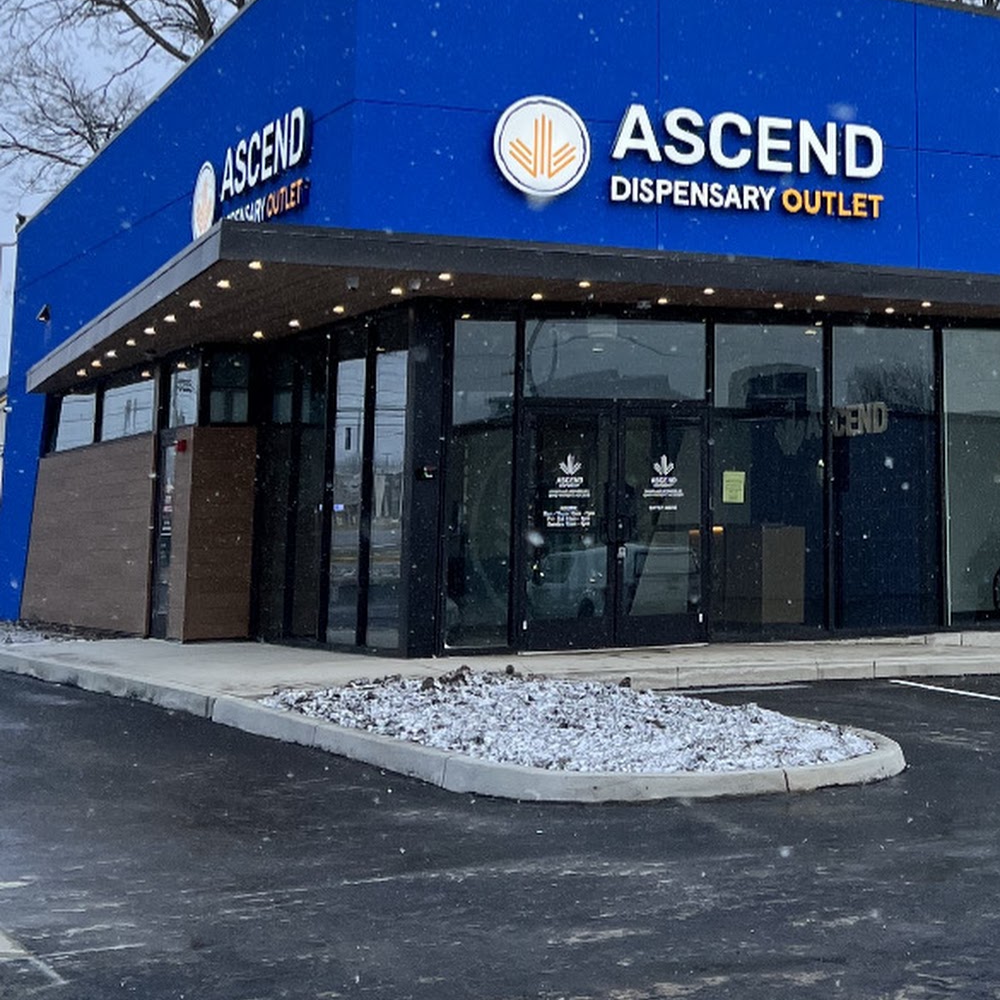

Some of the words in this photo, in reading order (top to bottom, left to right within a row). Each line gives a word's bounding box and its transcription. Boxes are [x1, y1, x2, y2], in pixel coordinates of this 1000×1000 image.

[220, 106, 305, 202] ASCEND
[611, 103, 884, 179] ASCEND
[266, 178, 304, 218] OUTLET
[610, 175, 776, 211] DISPENSARY
[781, 188, 884, 218] OUTLET
[804, 401, 889, 440] ACEND
